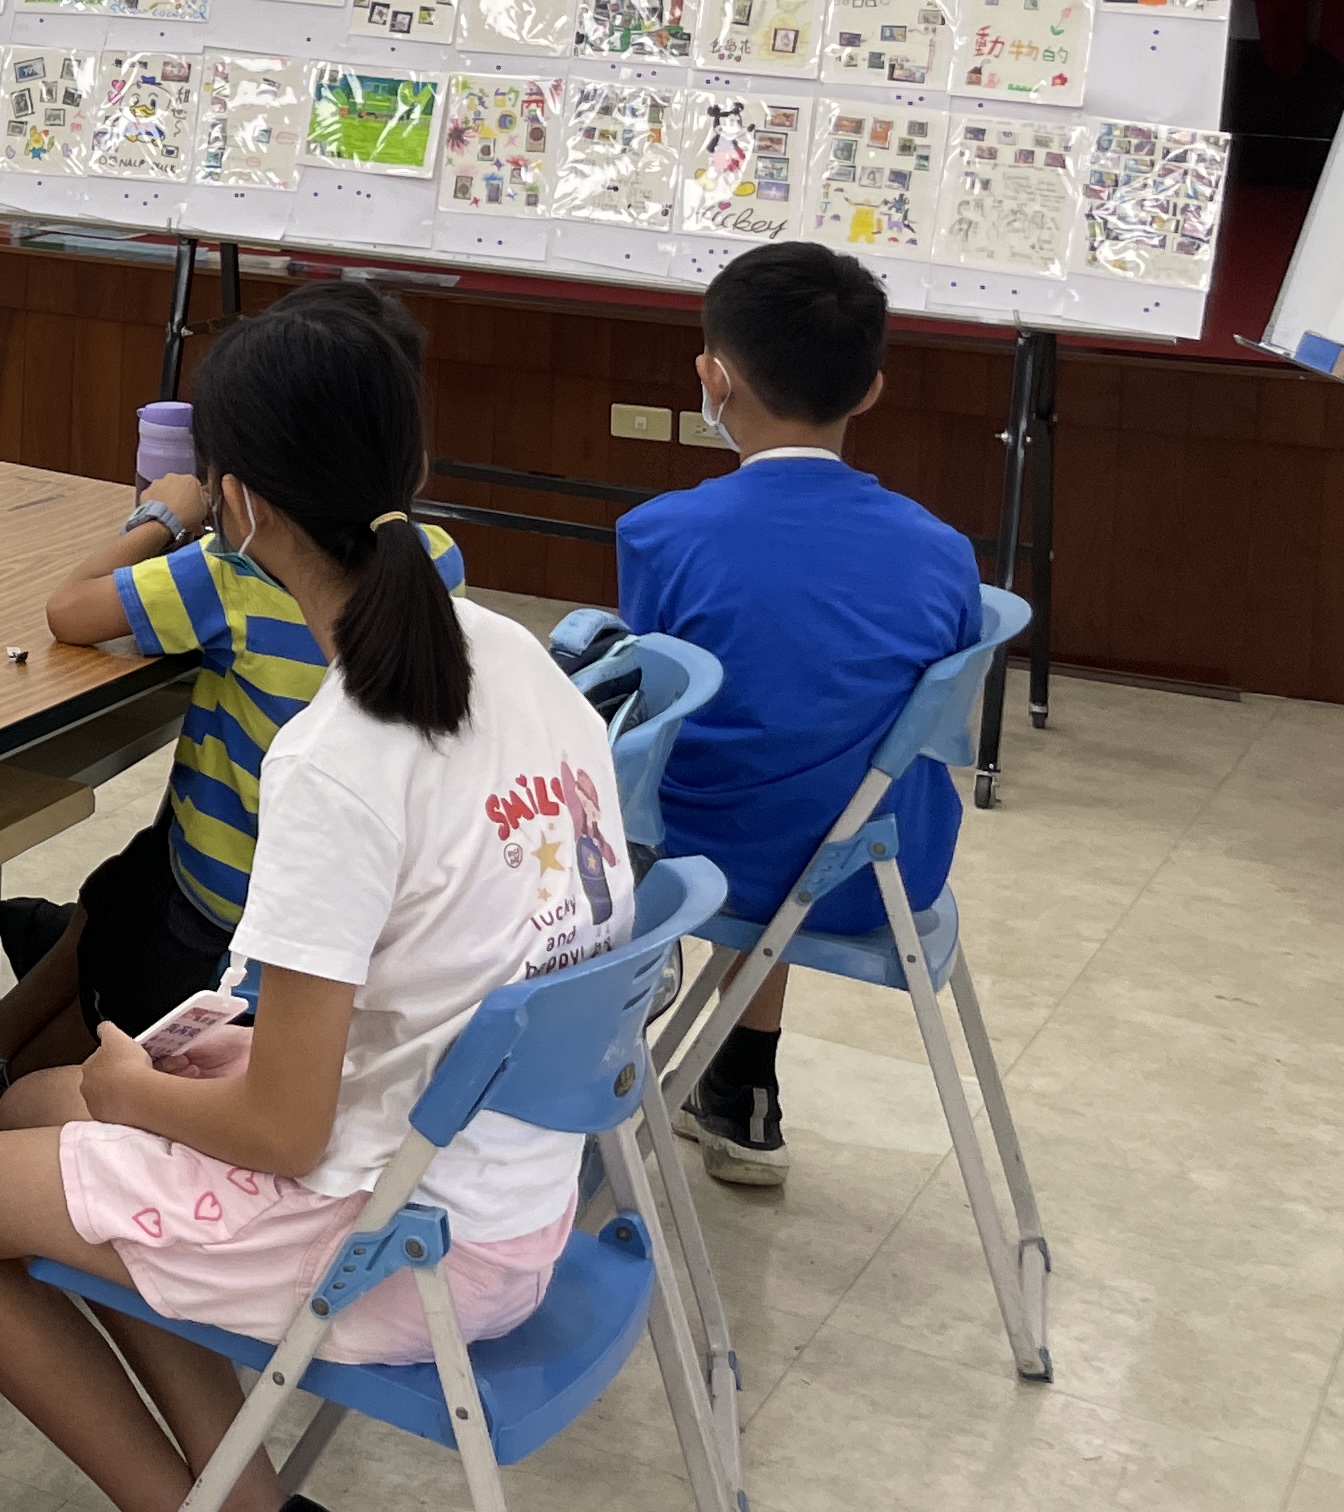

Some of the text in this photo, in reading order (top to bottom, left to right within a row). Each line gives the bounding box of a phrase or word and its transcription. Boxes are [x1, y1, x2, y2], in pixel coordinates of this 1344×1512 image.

[972, 24, 1070, 65] 動物的
[546, 925, 577, 952] and
